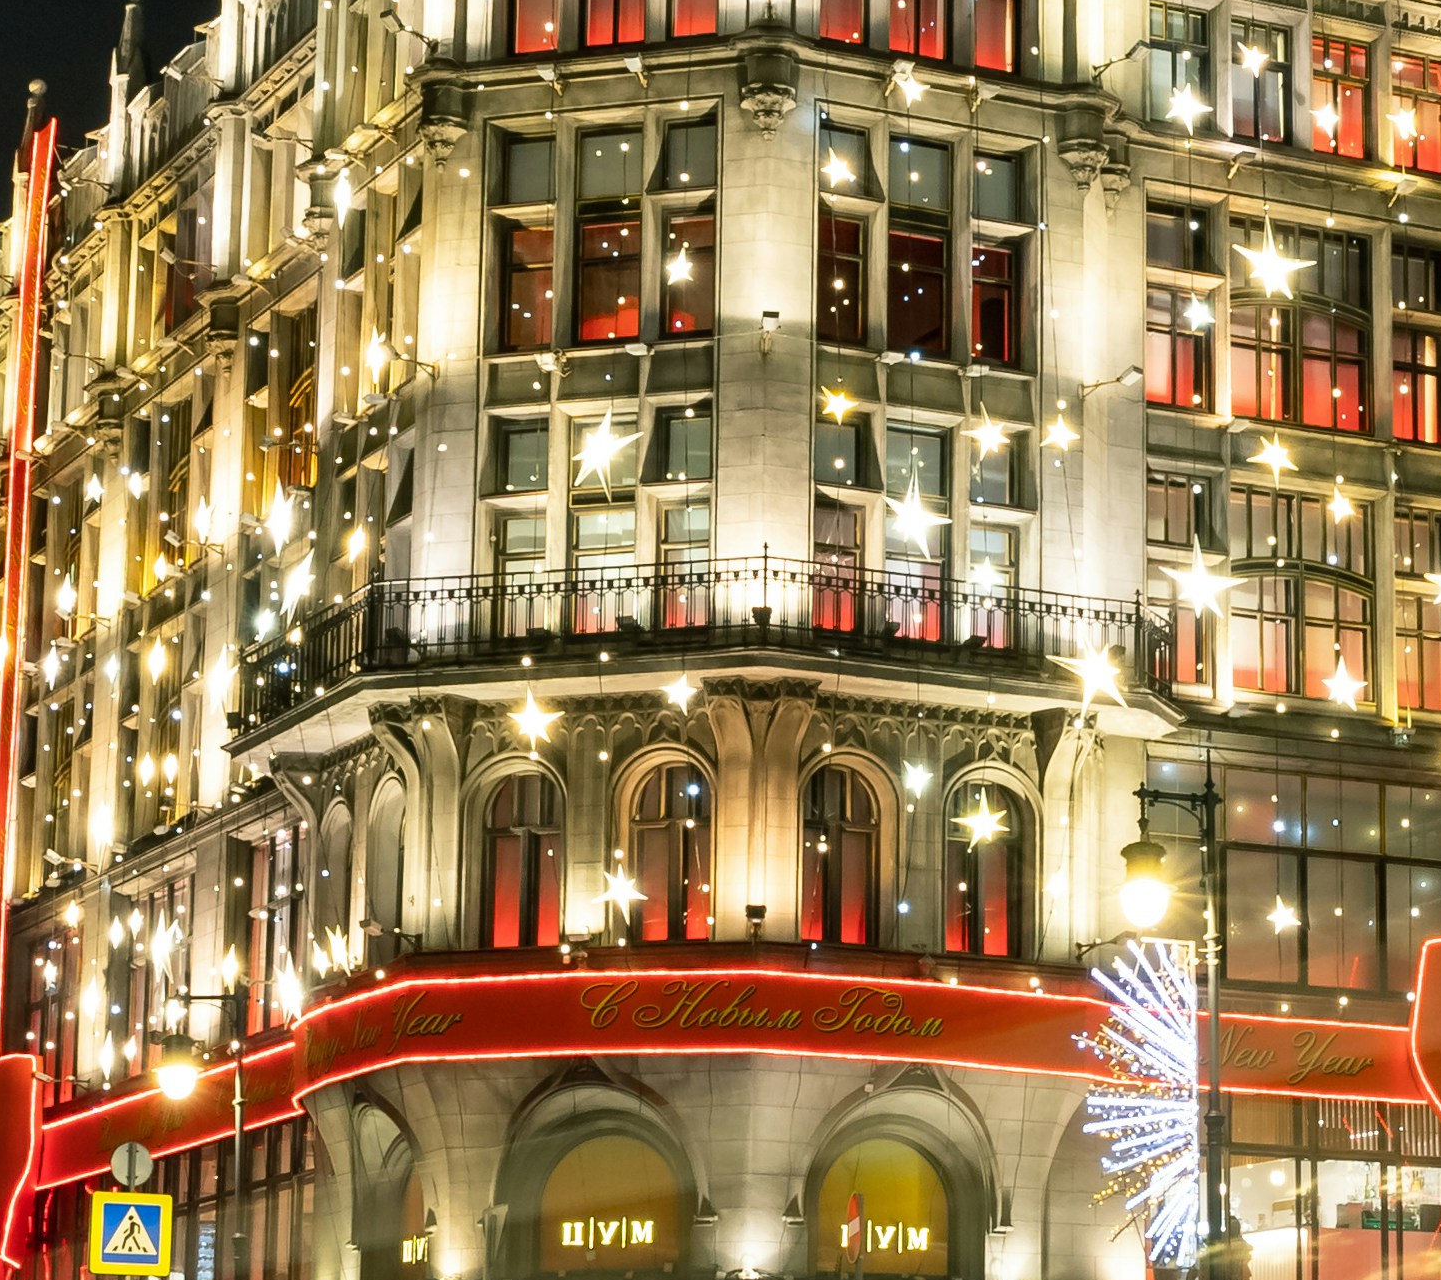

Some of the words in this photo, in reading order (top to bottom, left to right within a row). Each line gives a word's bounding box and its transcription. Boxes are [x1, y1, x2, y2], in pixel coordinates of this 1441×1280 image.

[386, 990, 463, 1056] Year
[579, 978, 640, 1030] С
[631, 977, 804, 1031] Новым
[811, 985, 945, 1038] Годом
[1199, 1022, 1278, 1069] New
[1286, 1028, 1375, 1085] Year
